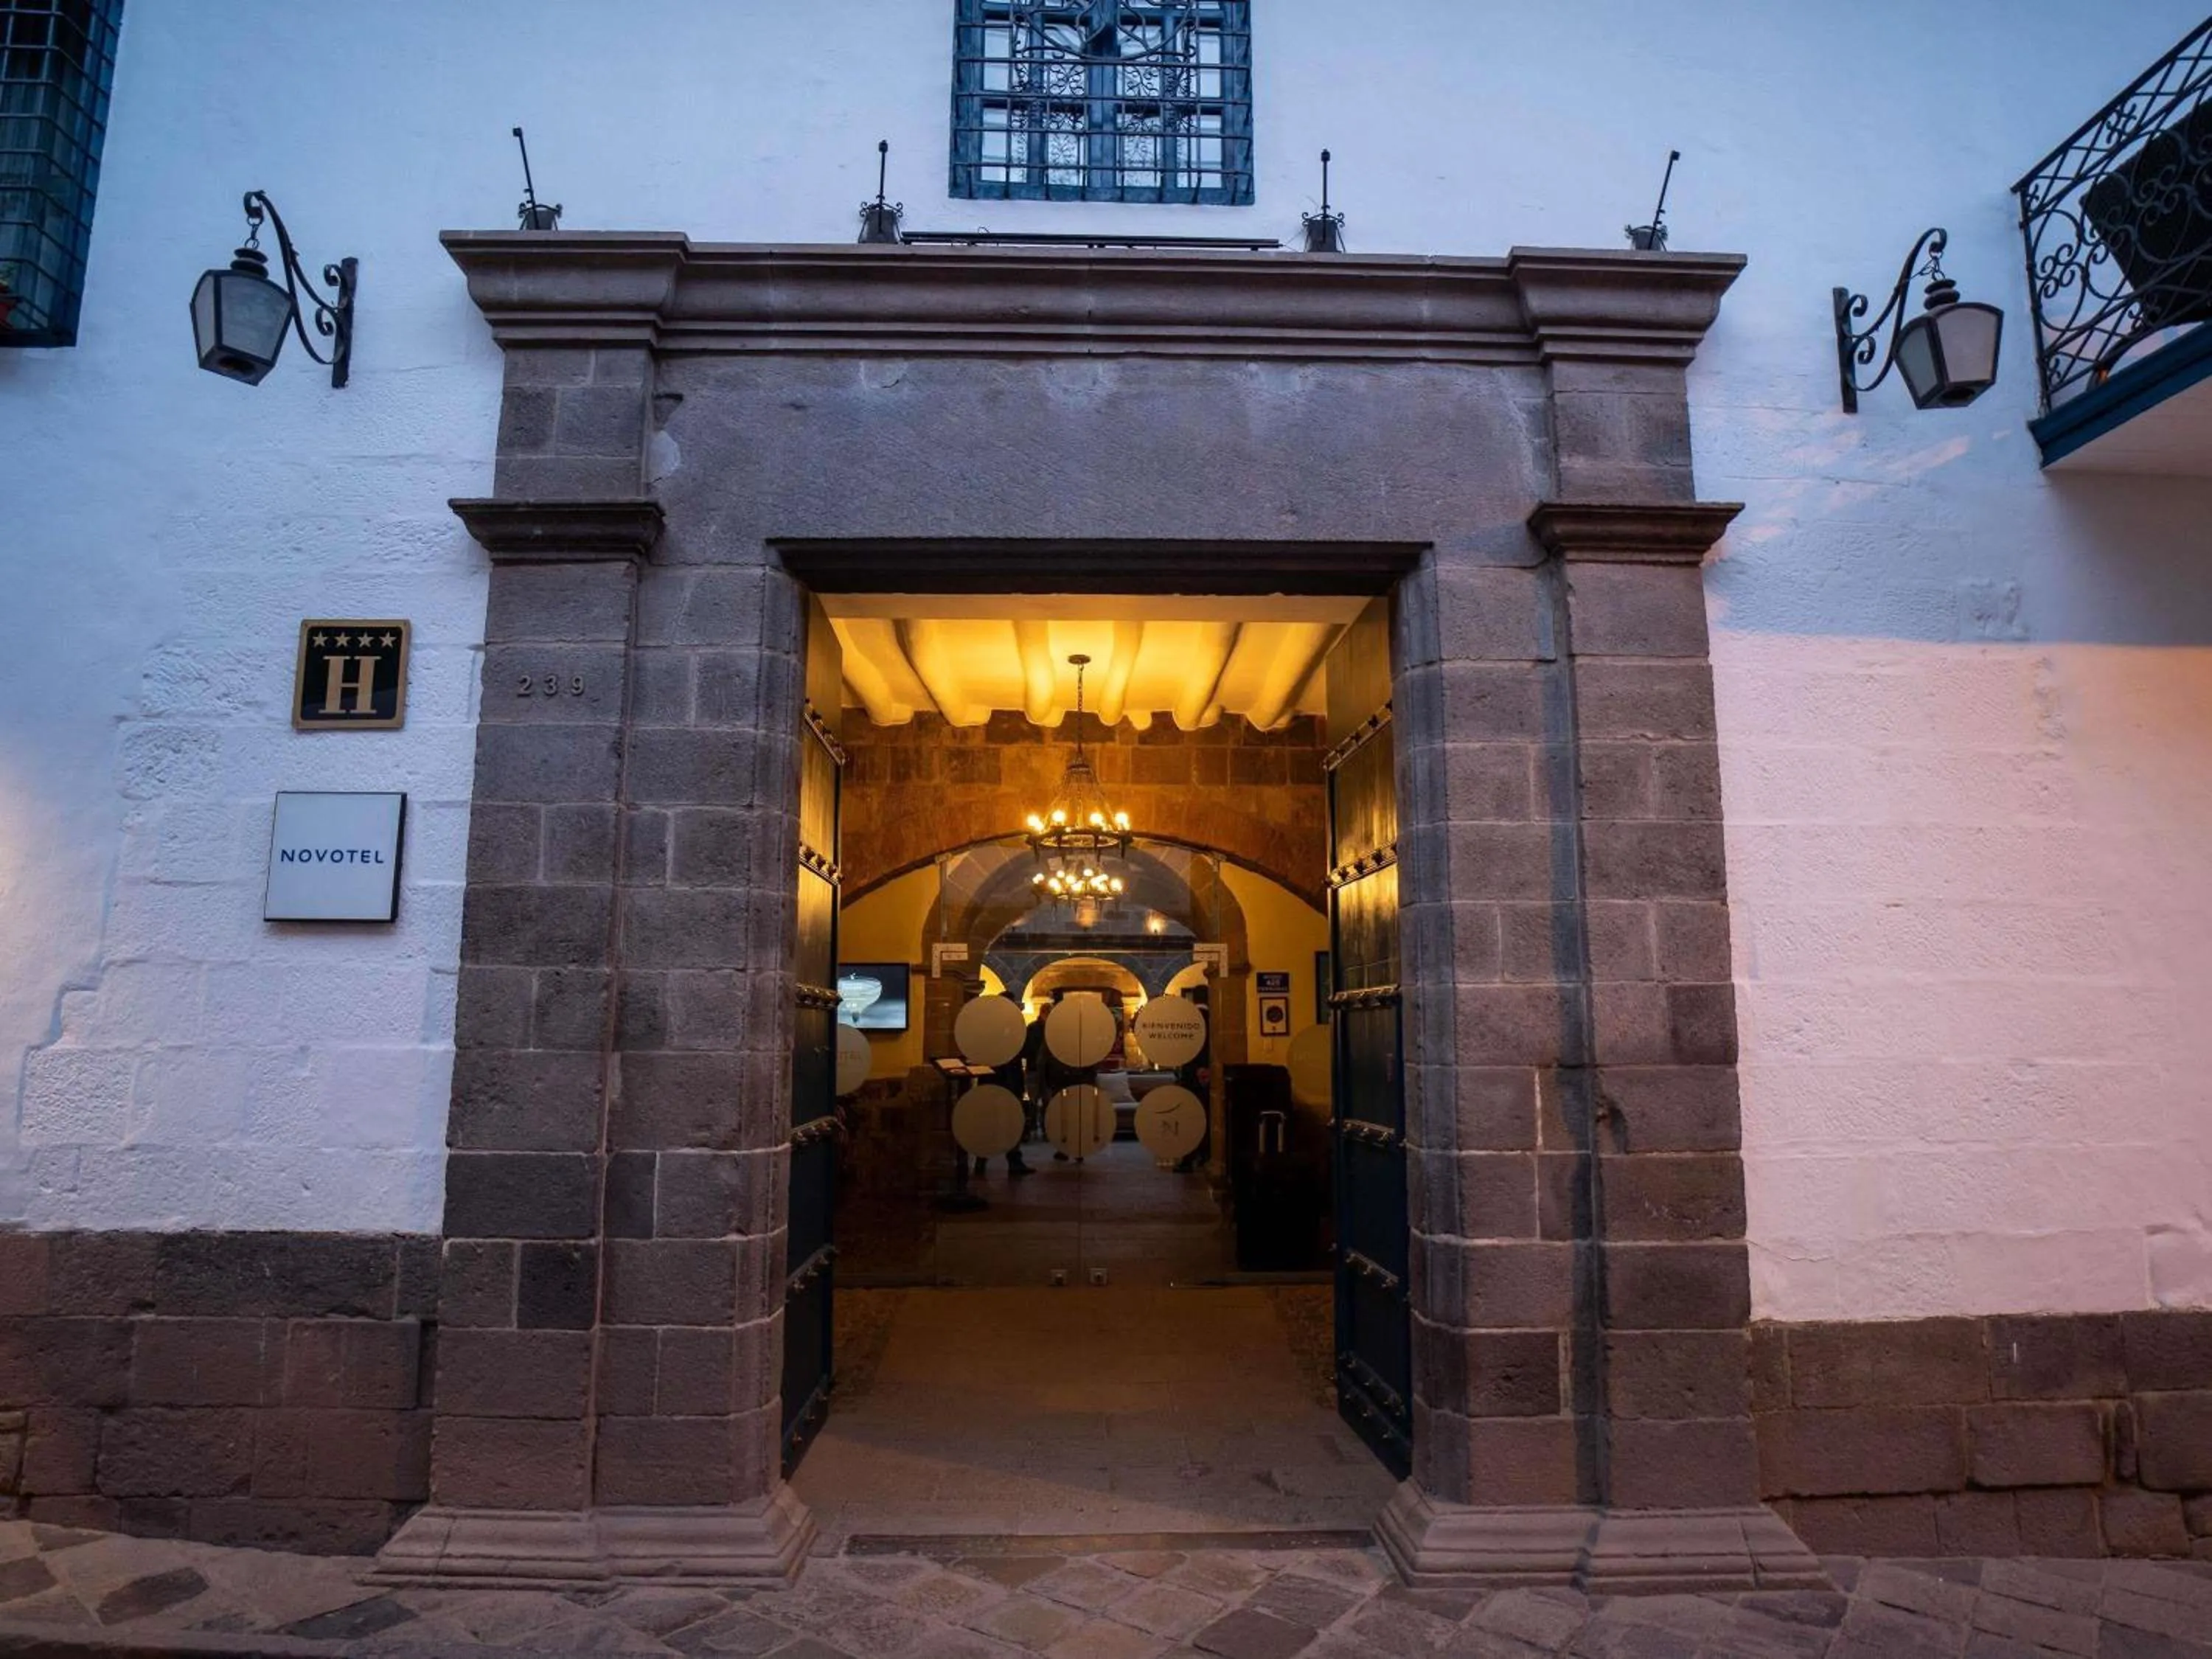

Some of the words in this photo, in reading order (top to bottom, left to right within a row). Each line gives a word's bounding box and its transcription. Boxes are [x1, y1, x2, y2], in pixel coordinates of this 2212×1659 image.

[319, 655, 382, 714] H
[516, 674, 584, 698] 239
[281, 849, 384, 863] NOVOTEL
